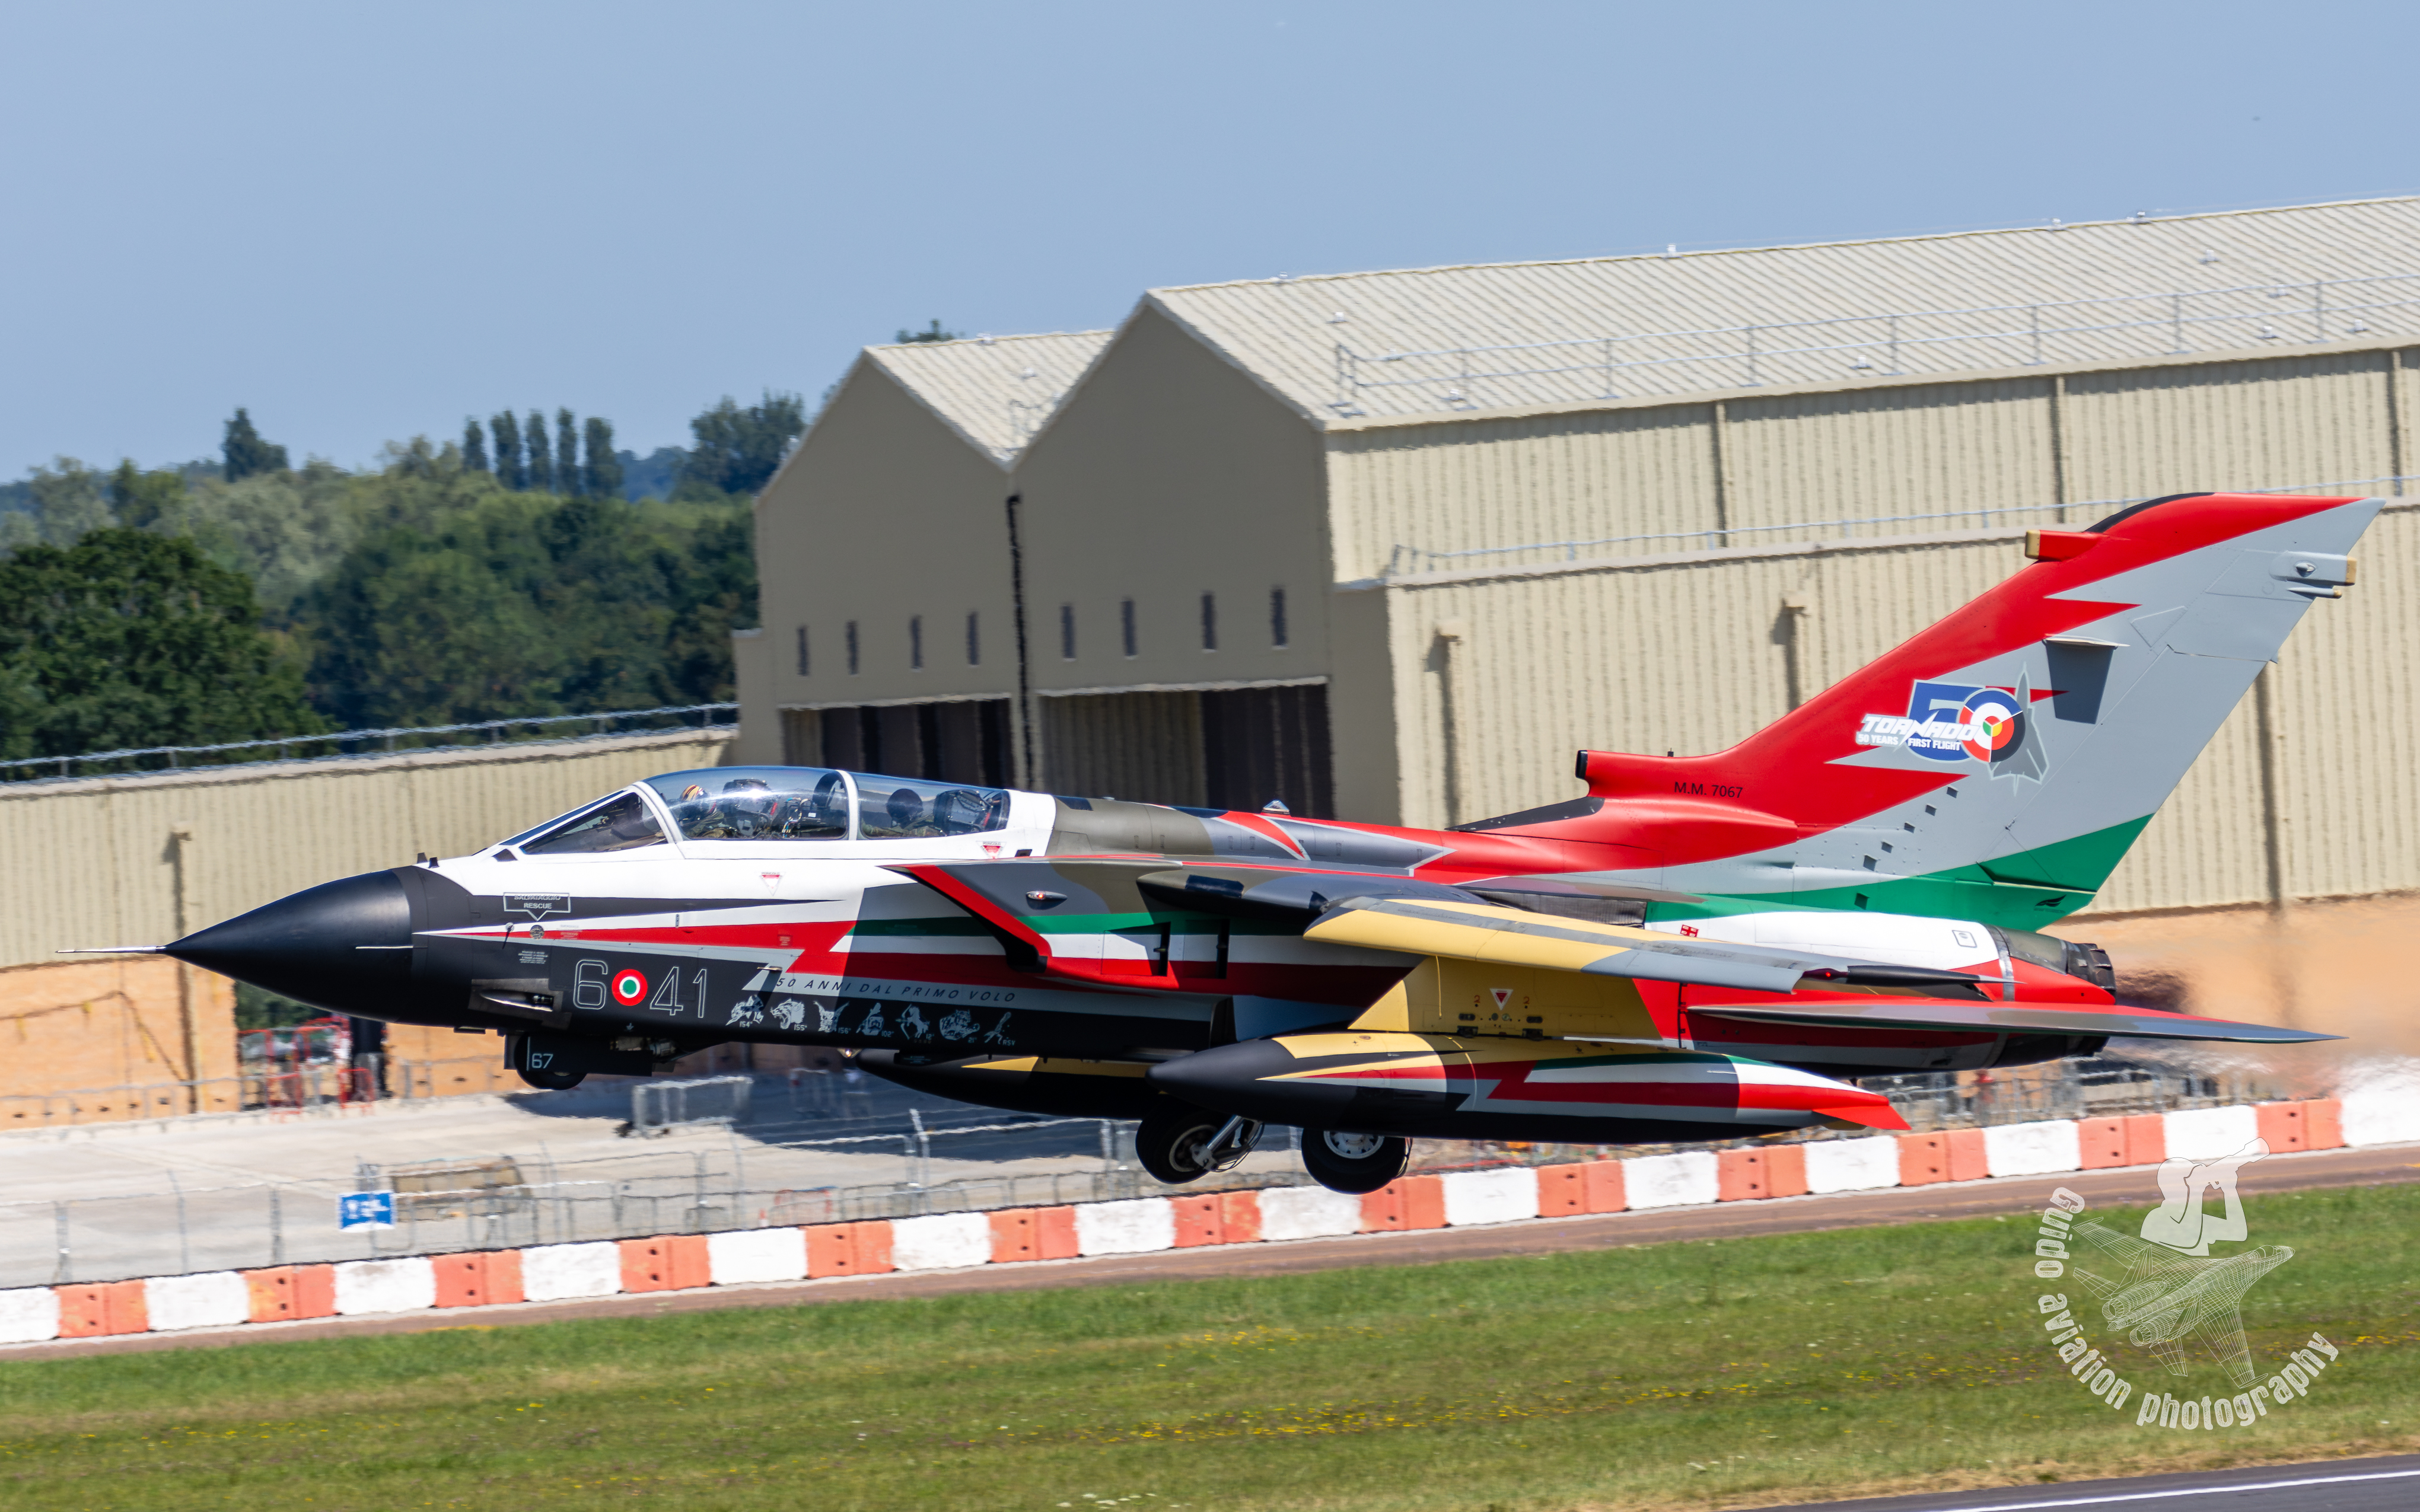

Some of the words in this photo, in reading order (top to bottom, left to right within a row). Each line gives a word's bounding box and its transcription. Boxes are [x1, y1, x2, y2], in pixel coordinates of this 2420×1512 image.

[1864, 710, 1981, 746] TORNADO
[1858, 733, 1869, 742] 50
[1871, 735, 1899, 745] YEARS
[1908, 738, 1932, 748] FIRST
[1932, 740, 1962, 751] FLIGHT
[1674, 781, 1706, 795] M.M.
[1711, 784, 1743, 798] 7067
[573, 959, 608, 1010] 6
[649, 966, 708, 1019] 41
[776, 978, 797, 987] 50
[804, 980, 851, 991] ANNI
[859, 984, 891, 994] DAL
[902, 986, 959, 999] PRIMO
[969, 991, 1015, 1002] VOLO
[1474, 995, 1480, 1003] 2
[1523, 996, 1530, 1004] 2
[531, 1053, 553, 1069] 67
